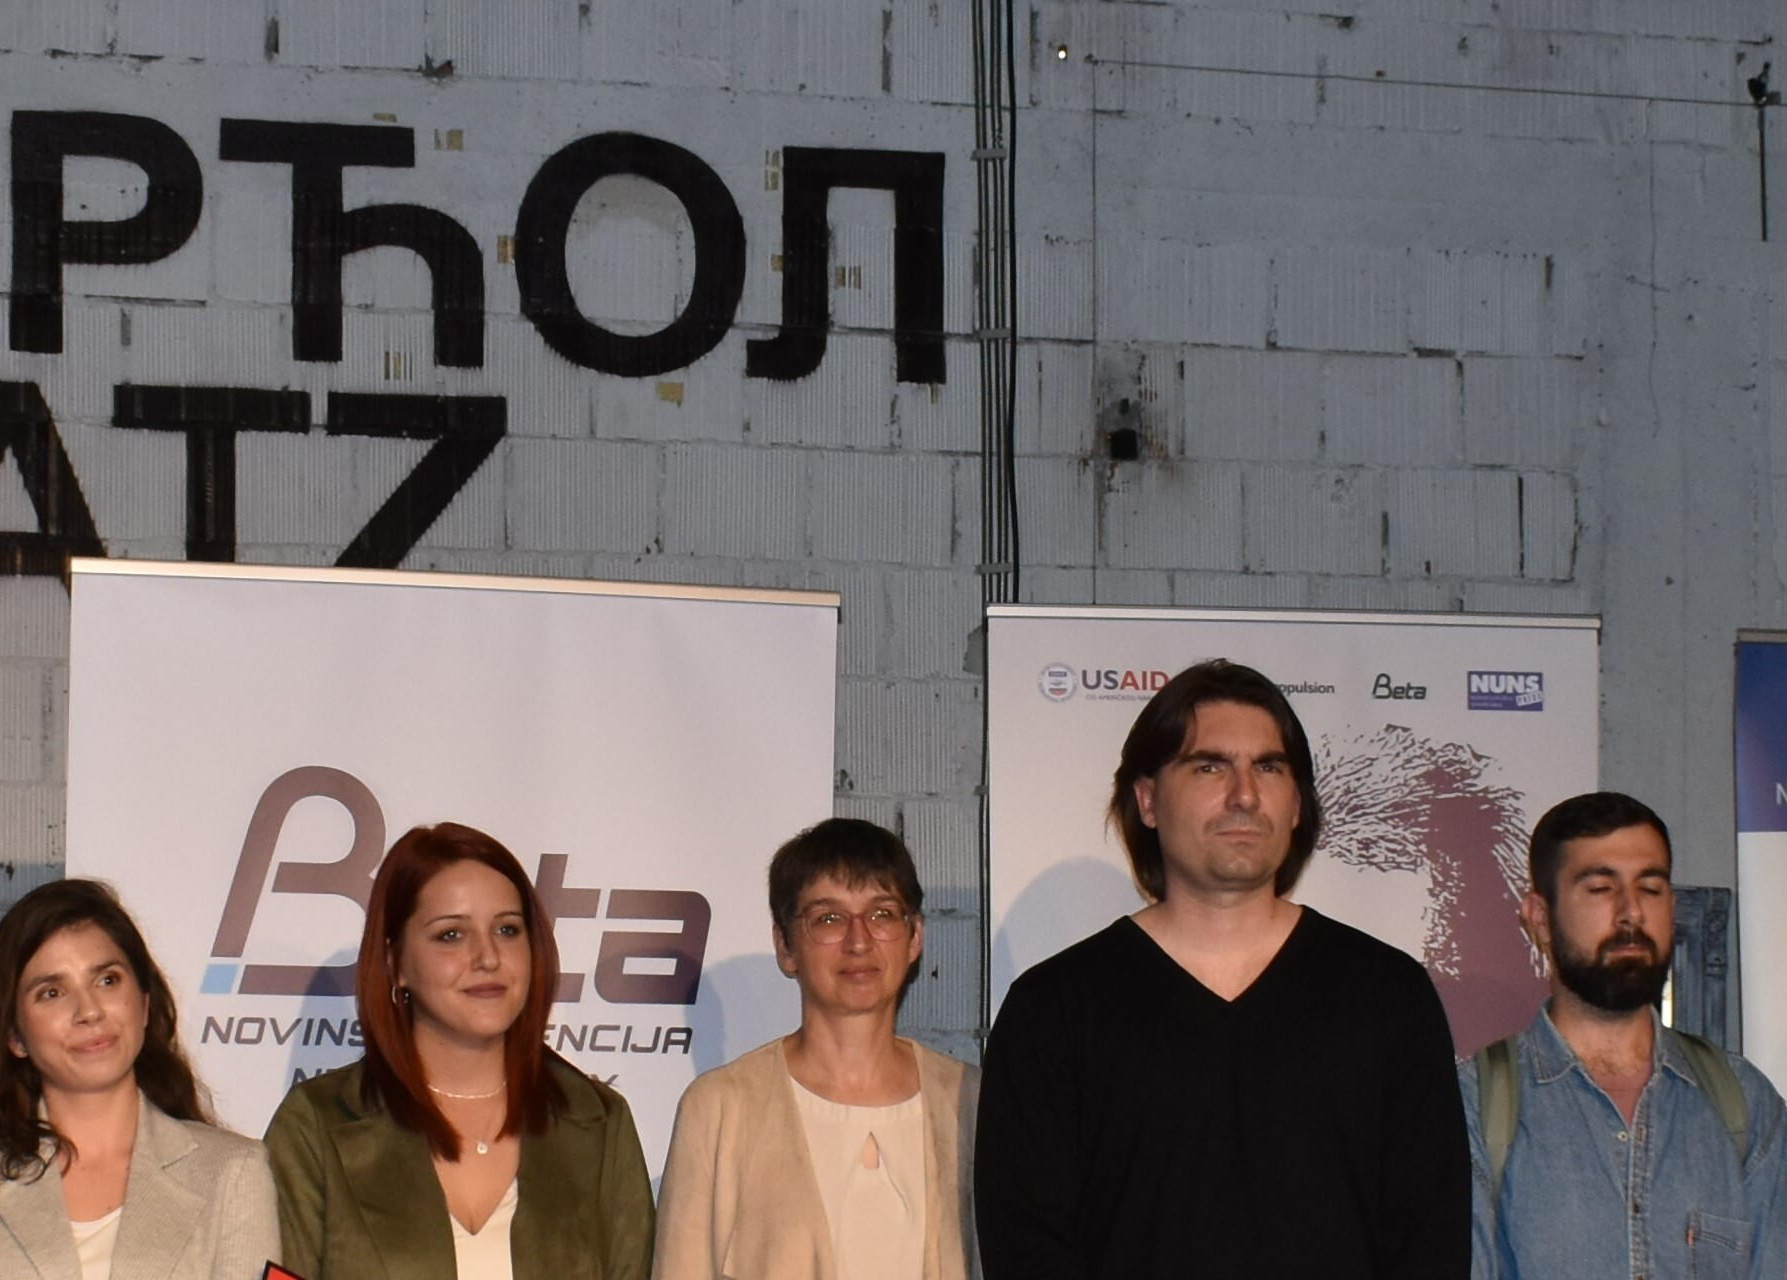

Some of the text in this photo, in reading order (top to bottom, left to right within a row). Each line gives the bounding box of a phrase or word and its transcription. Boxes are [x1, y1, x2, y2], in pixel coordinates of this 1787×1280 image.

[1081, 669, 1170, 692] USAID
[1372, 672, 1427, 700] Beta
[1469, 673, 1540, 694] NUNS
[199, 765, 712, 1006] Bta
[200, 1015, 693, 1056] NOVINS ENCIJA
